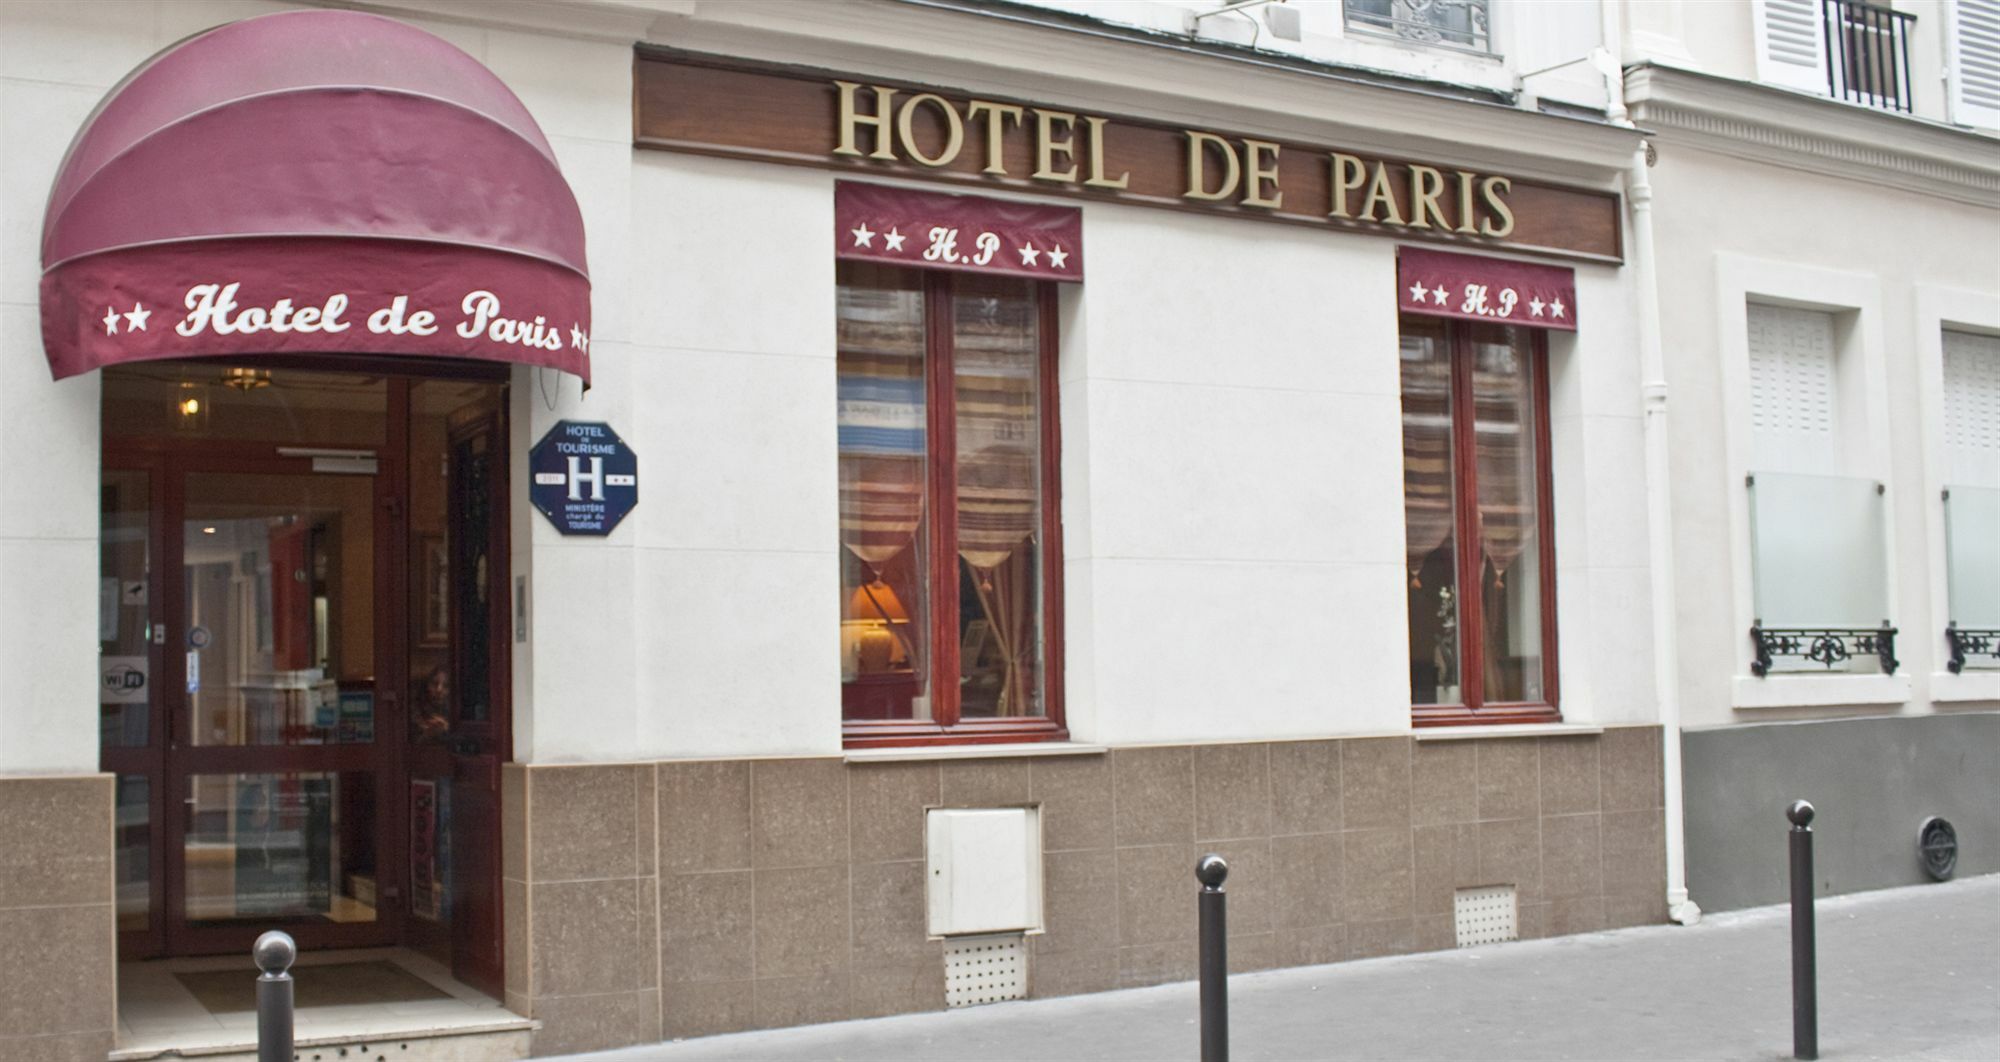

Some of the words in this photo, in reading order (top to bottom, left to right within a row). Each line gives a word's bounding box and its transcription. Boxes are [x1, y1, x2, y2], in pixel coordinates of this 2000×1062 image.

[833, 80, 1129, 189] HOTEL
[1184, 130, 1283, 209] DE
[1329, 152, 1515, 237] PARIS
[175, 282, 351, 337] Hotel
[367, 295, 439, 336] de
[456, 290, 563, 350] Paris
[566, 426, 604, 437] HOTEL
[556, 443, 615, 454] TOURISME
[567, 456, 605, 501] H
[568, 521, 602, 529] TOURISME
